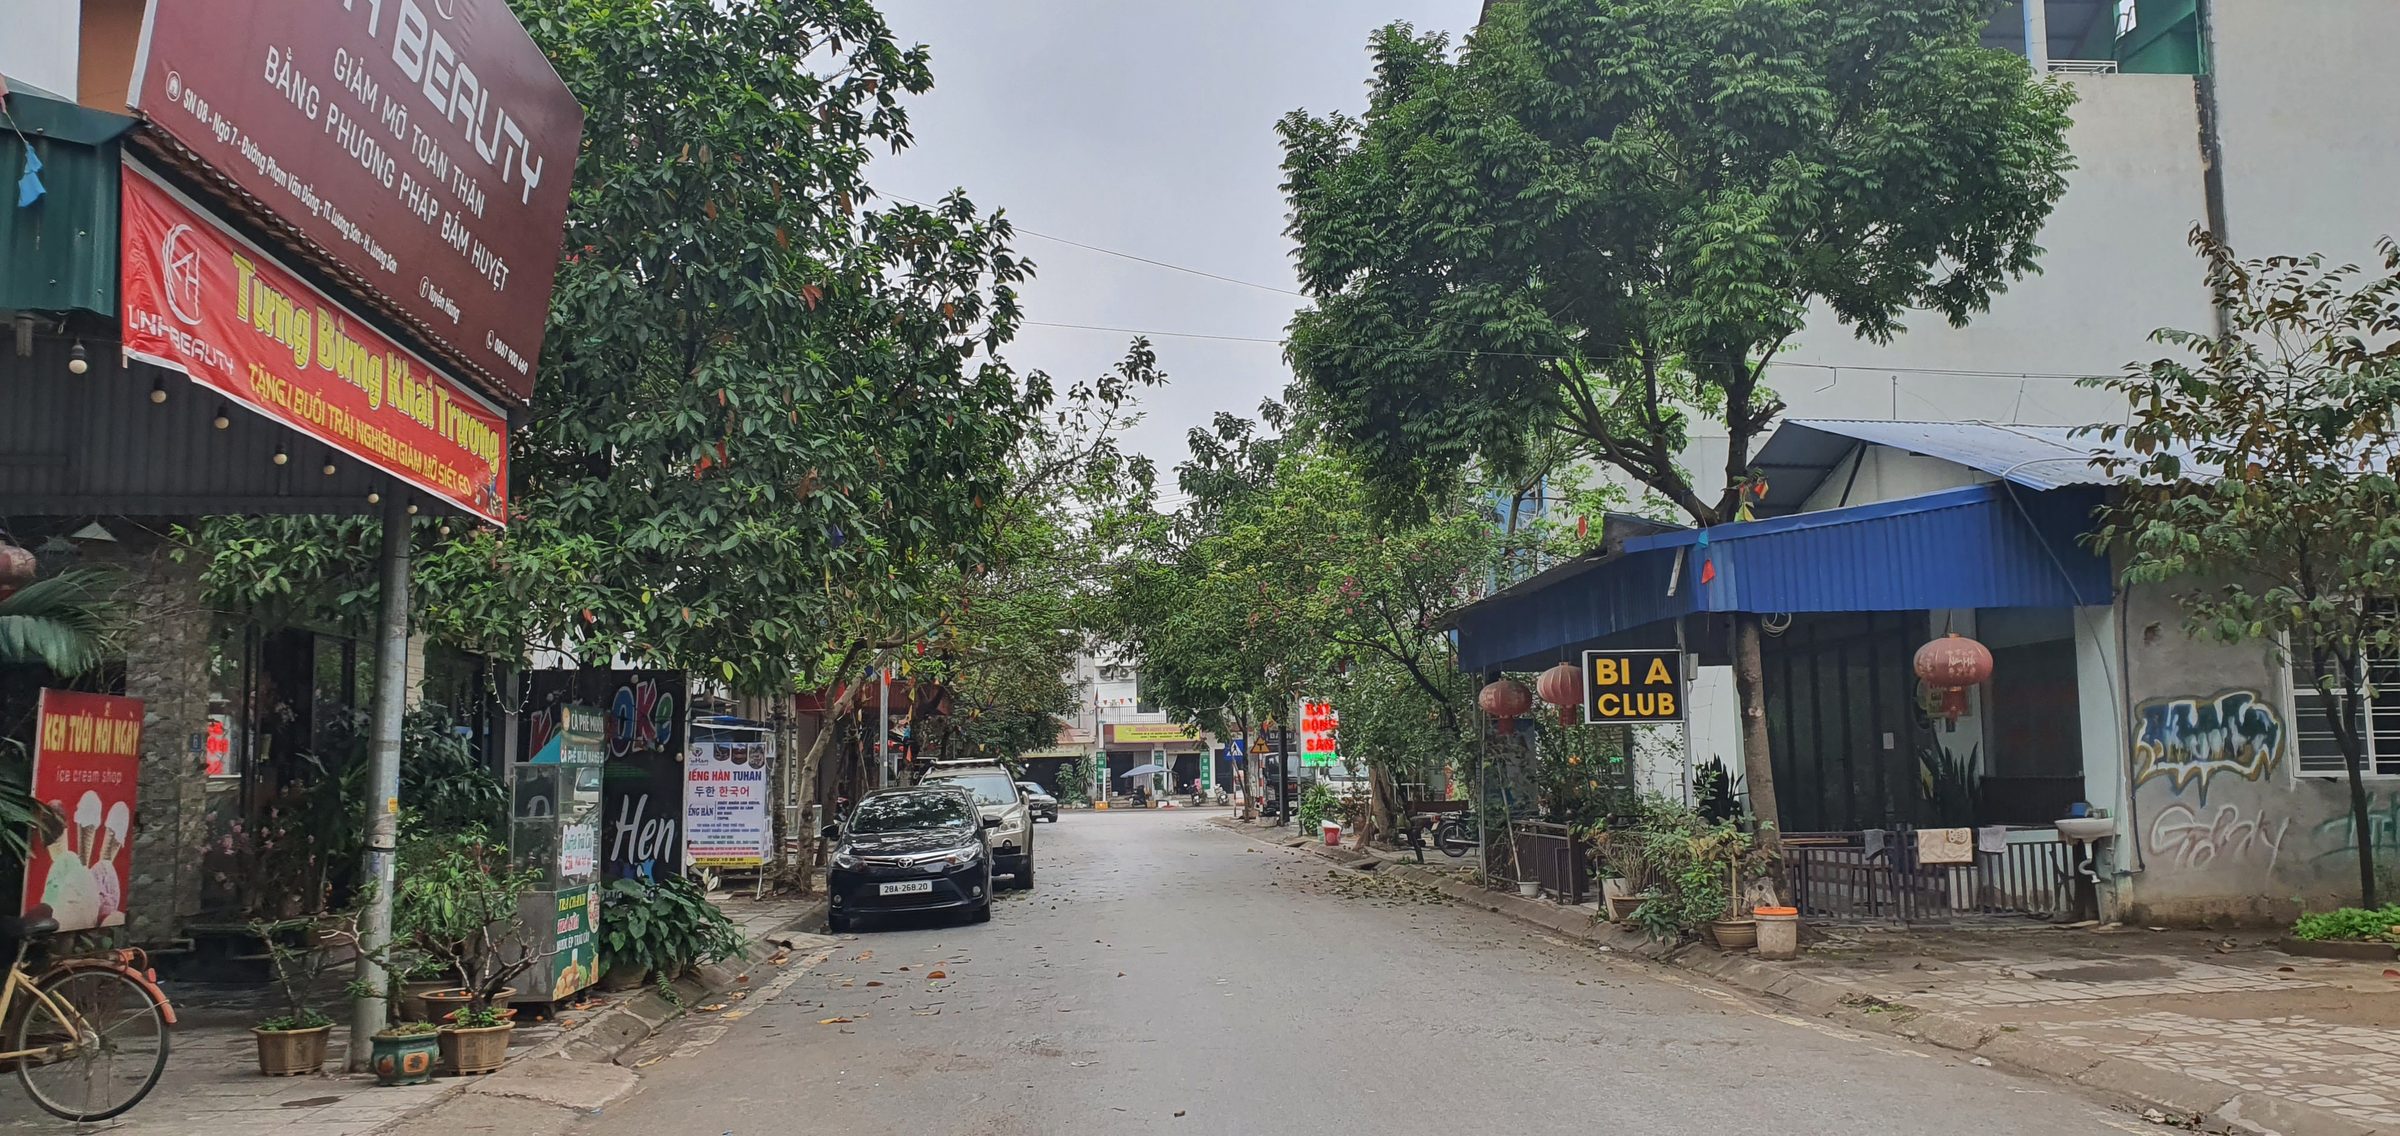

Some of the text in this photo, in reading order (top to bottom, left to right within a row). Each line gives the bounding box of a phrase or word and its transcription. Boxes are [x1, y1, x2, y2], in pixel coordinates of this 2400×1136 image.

[183, 87, 197, 114] SN
[196, 98, 209, 123] 08
[230, 126, 239, 146] 7
[392, 0, 543, 205] BEAUTY
[333, 47, 379, 112] GIẢM
[411, 123, 449, 183] TOÀN
[451, 164, 485, 219] THÂN
[264, 44, 320, 121] BẰNG
[398, 171, 439, 225] PHÁP
[440, 209, 470, 257] BẤM
[471, 239, 510, 292] HUYỆT
[168, 328, 235, 376] BEAUTY
[316, 305, 383, 411] Bừng
[386, 350, 435, 431] Khai
[1596, 657, 1673, 685] BI A
[1597, 693, 1675, 717] CLUB
[43, 711, 67, 752] KEM
[113, 711, 140, 756] NGÀY
[56, 765, 122, 786] ice cream shop
[688, 767, 762, 781] IẾNG HÀN TUHAN
[694, 786, 750, 797] 두한 한국어
[884, 882, 929, 894] 28A-268.20
